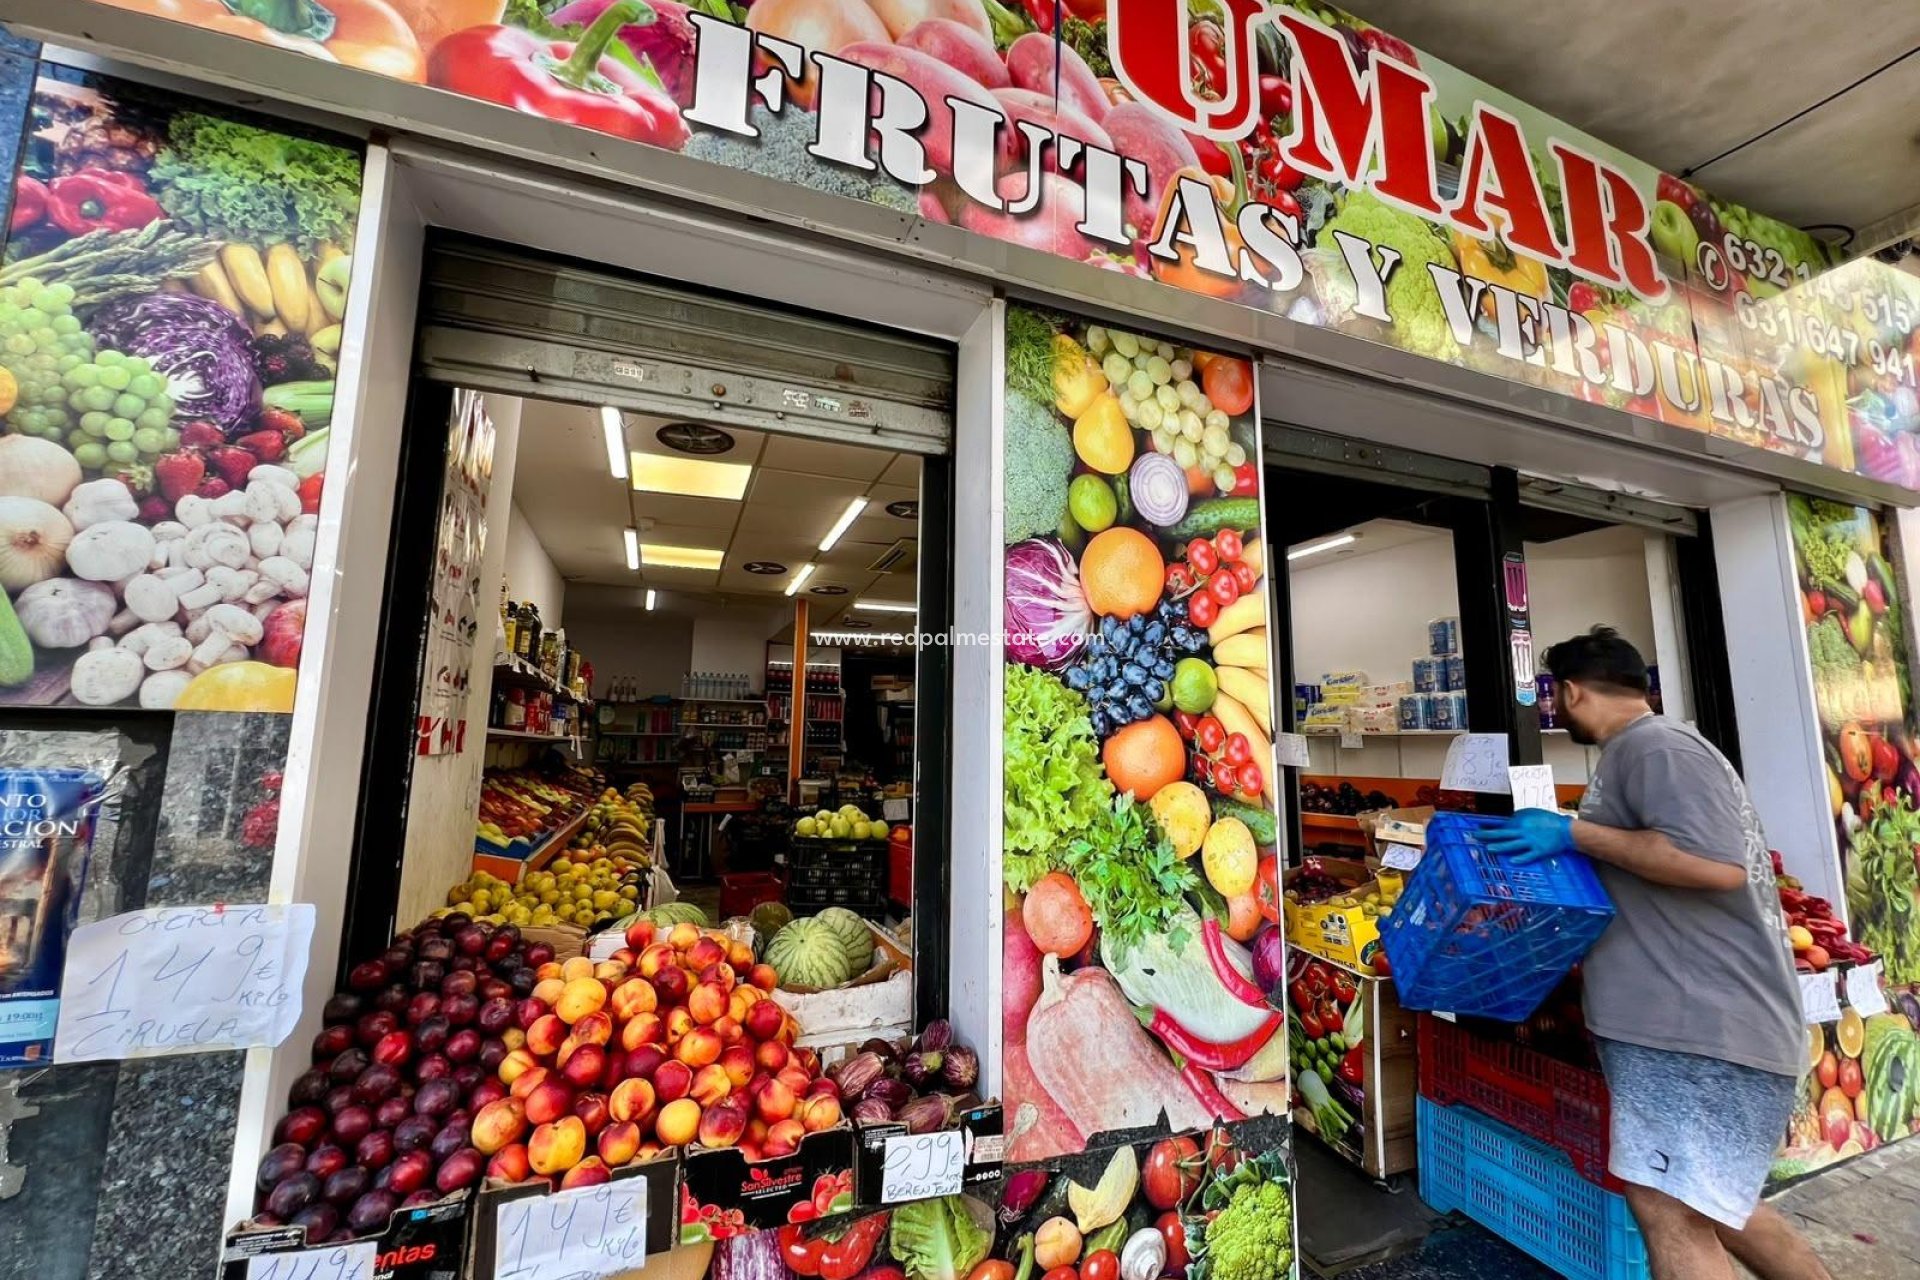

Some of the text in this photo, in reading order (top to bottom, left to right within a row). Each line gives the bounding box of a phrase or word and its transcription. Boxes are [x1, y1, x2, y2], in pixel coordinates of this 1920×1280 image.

[682, 11, 1826, 450] FRUTAS Y VERDURAS
[1106, 0, 1671, 306] UMAR
[1723, 231, 1789, 288] 632
[1862, 287, 1911, 334] 515
[1734, 290, 1917, 388] 631 647 941
